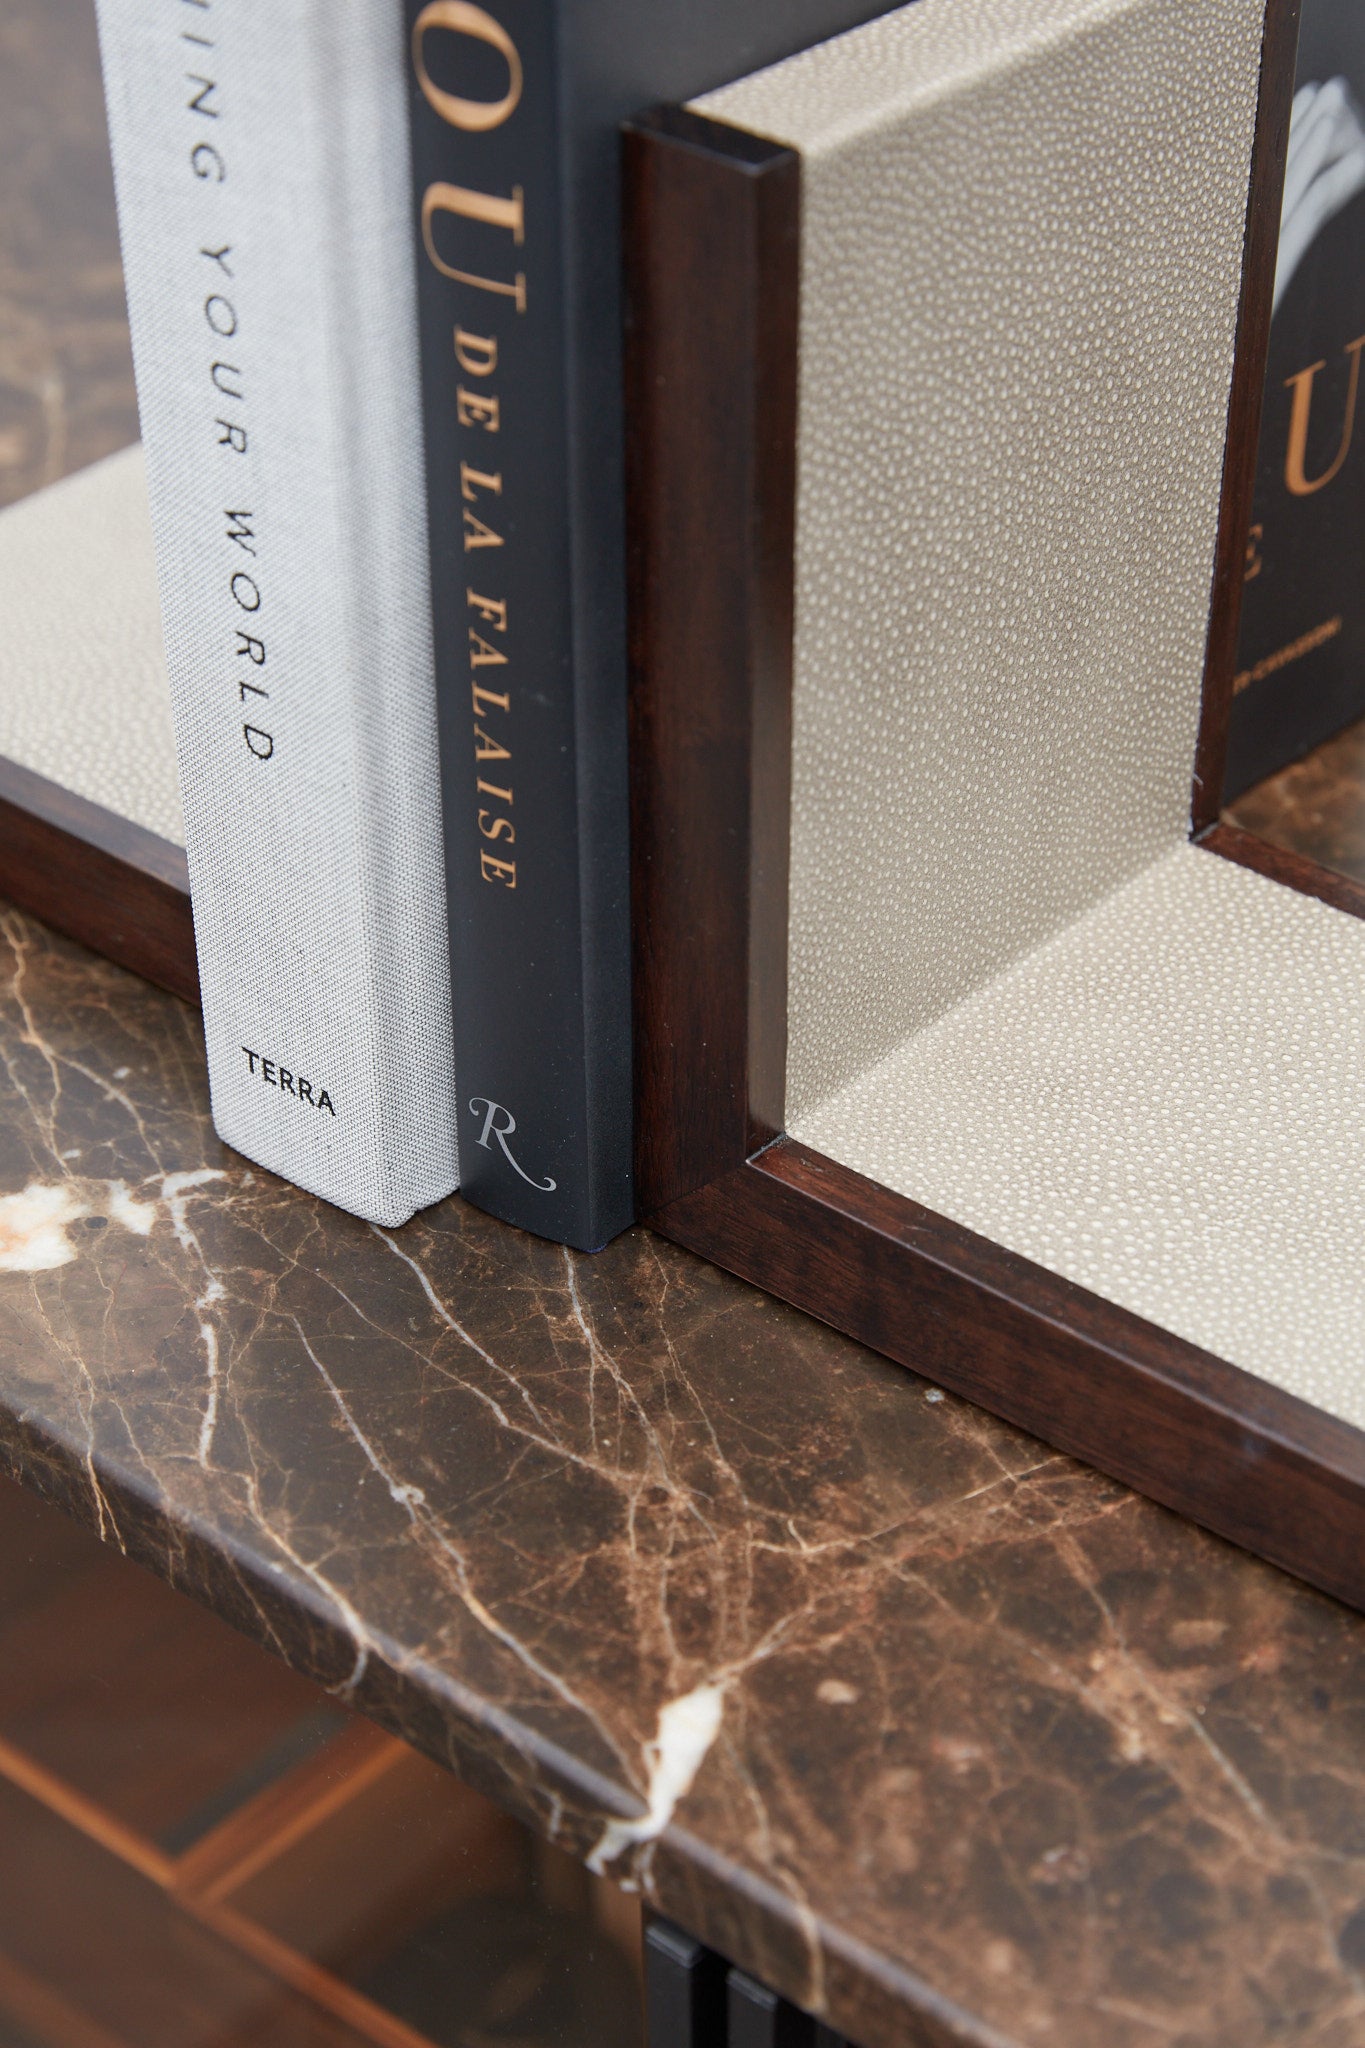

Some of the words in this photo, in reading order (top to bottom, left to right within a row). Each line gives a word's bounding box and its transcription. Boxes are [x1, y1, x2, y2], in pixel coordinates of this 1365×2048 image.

[180, 0, 226, 182] ING
[199, 246, 247, 453] YOUR
[453, 324, 500, 433] DE
[460, 460, 505, 553] LA
[224, 510, 274, 760] WORLD
[467, 586, 517, 889] FALAISE
[241, 1046, 336, 1117] TERRA
[468, 1097, 557, 1192] R
